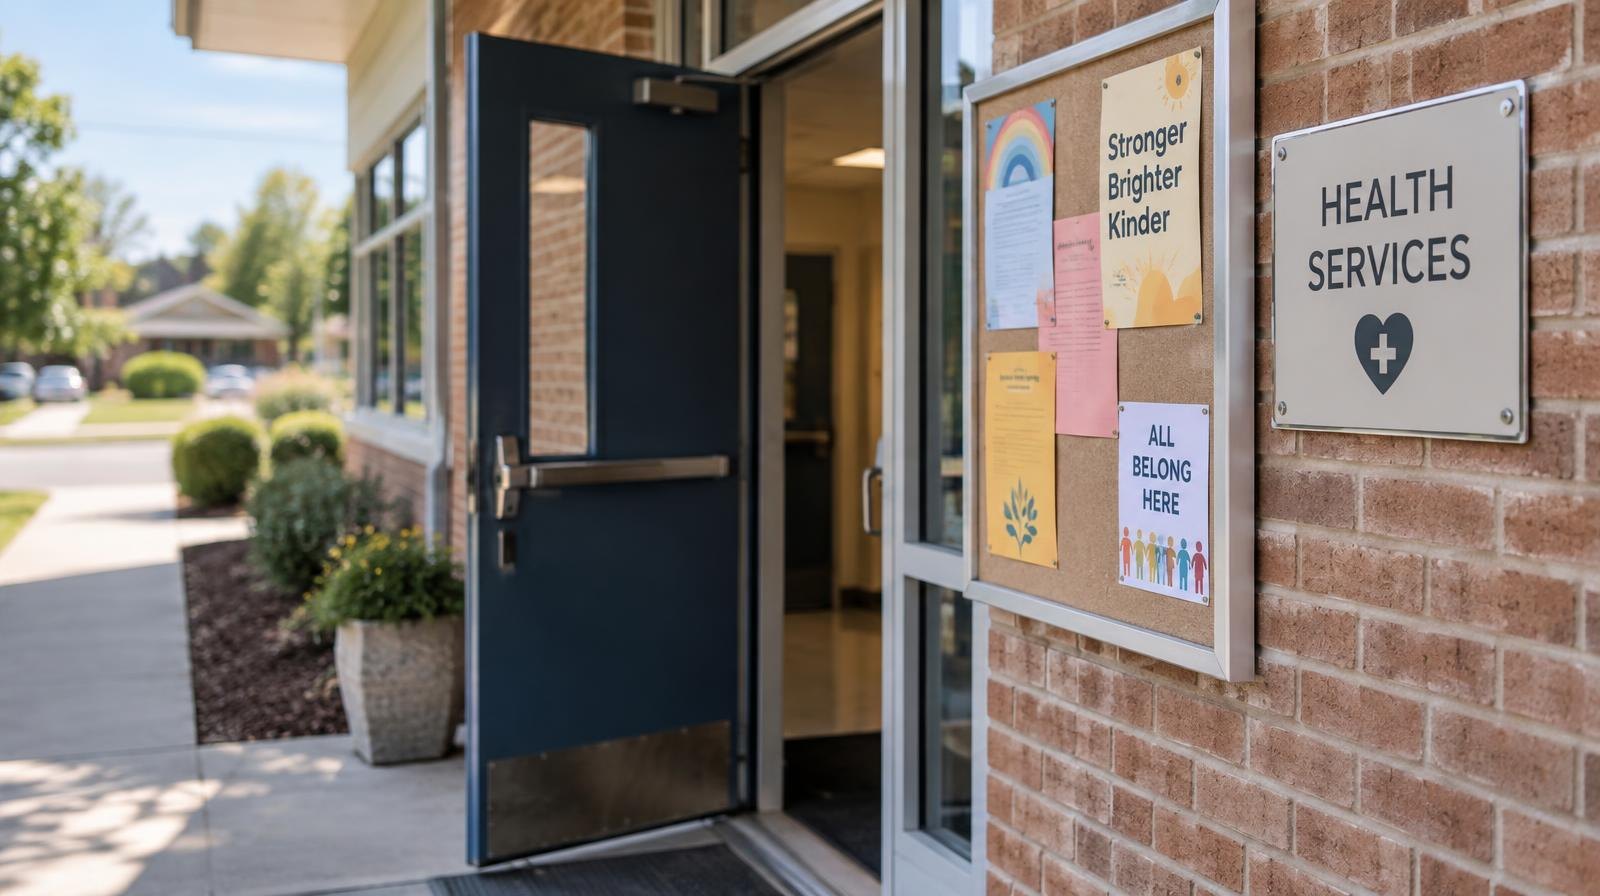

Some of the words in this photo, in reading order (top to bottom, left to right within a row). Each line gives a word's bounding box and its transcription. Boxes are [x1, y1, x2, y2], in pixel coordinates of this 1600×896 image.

[1108, 121, 1188, 161] Stronger
[1108, 164, 1182, 203] Brighter
[1322, 165, 1453, 227] HEALTH
[1108, 206, 1171, 240] Kinder
[1308, 234, 1471, 292] SERVICES
[1148, 424, 1175, 448] ALL
[1132, 455, 1192, 483] BELONG
[1142, 488, 1180, 516] HERE
